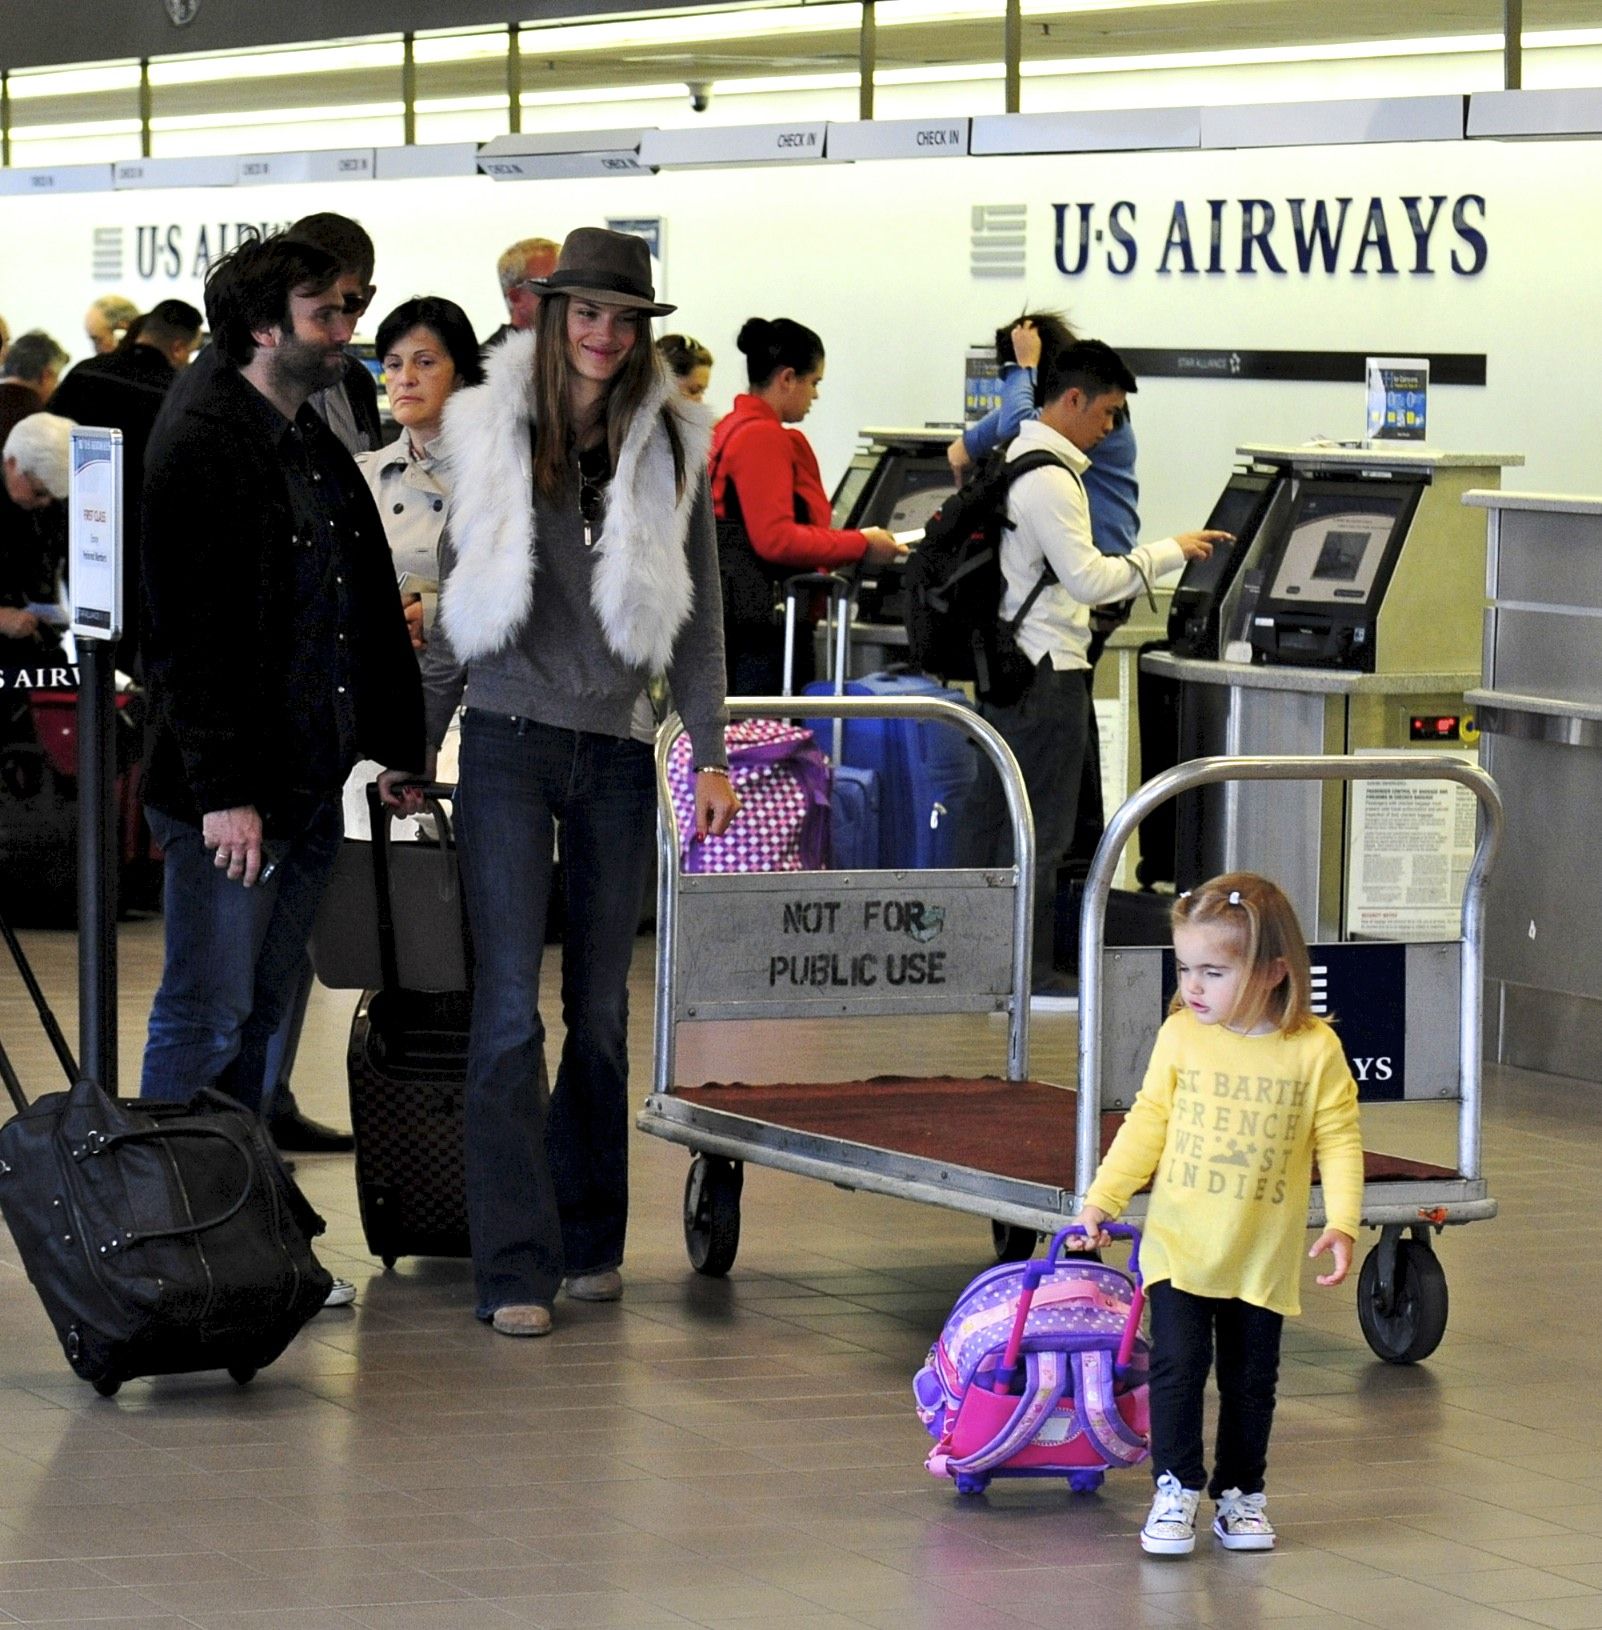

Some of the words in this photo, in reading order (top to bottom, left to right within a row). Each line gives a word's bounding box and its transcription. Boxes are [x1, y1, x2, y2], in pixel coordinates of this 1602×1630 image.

[777, 133, 804, 147] CHECK
[807, 132, 817, 146] IN
[916, 130, 946, 146] CHECK
[949, 130, 959, 145] IN
[487, 164, 512, 174] CHECK
[512, 163, 523, 173] IN
[602, 158, 627, 170] CHECK
[628, 158, 641, 169] IN
[1155, 194, 1488, 275] AIRWAYS
[783, 901, 841, 934] NOT
[863, 900, 928, 933] FOR
[769, 952, 878, 987] PUBLIC
[886, 951, 947, 986] USE
[1176, 1068, 1201, 1094] ST
[1213, 1072, 1310, 1107] BARTH
[1176, 1097, 1301, 1141] FRENCH
[1166, 1159, 1287, 1205] INDIES
